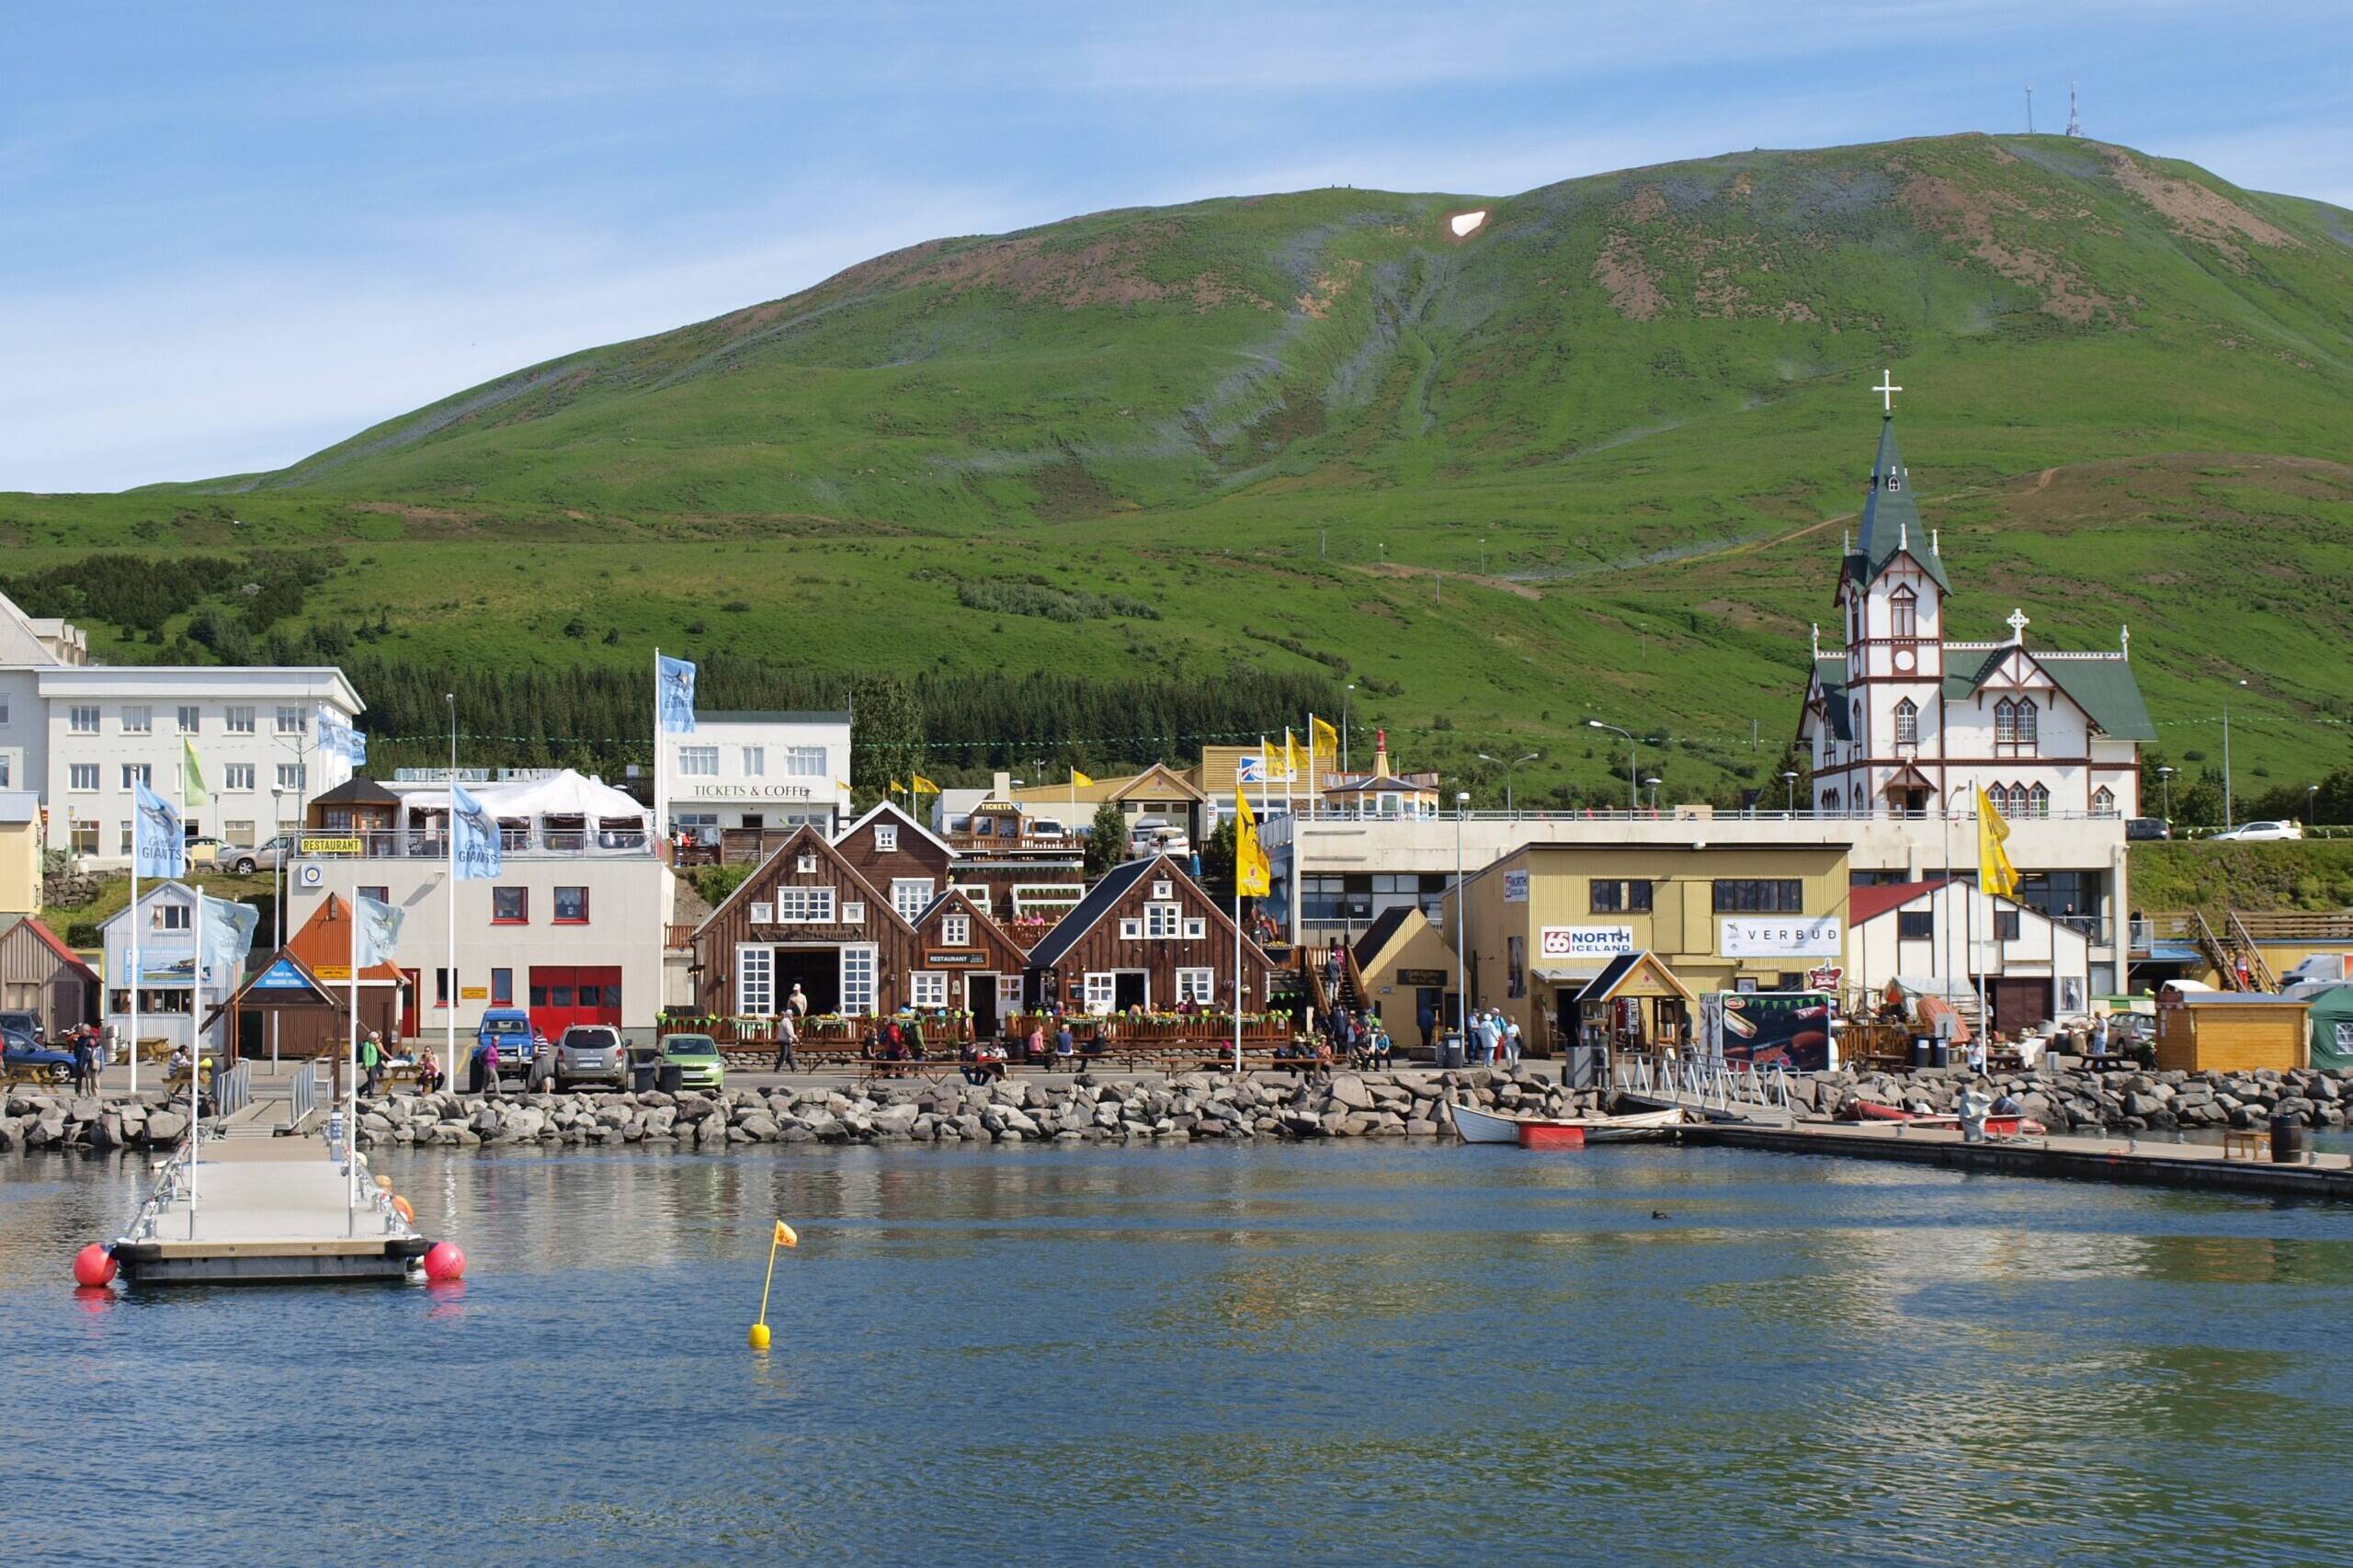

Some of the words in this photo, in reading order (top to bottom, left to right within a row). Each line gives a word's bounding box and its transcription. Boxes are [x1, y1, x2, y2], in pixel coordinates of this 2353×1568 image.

[694, 785, 745, 796] TICKETS
[750, 787, 759, 796] &
[765, 786, 812, 797] COFFE
[303, 840, 359, 850] RESTAURANT
[142, 846, 182, 860] GIANTS
[459, 851, 497, 864] GIANTS
[1545, 932, 1570, 953] 66
[1572, 933, 1631, 943] NORTH
